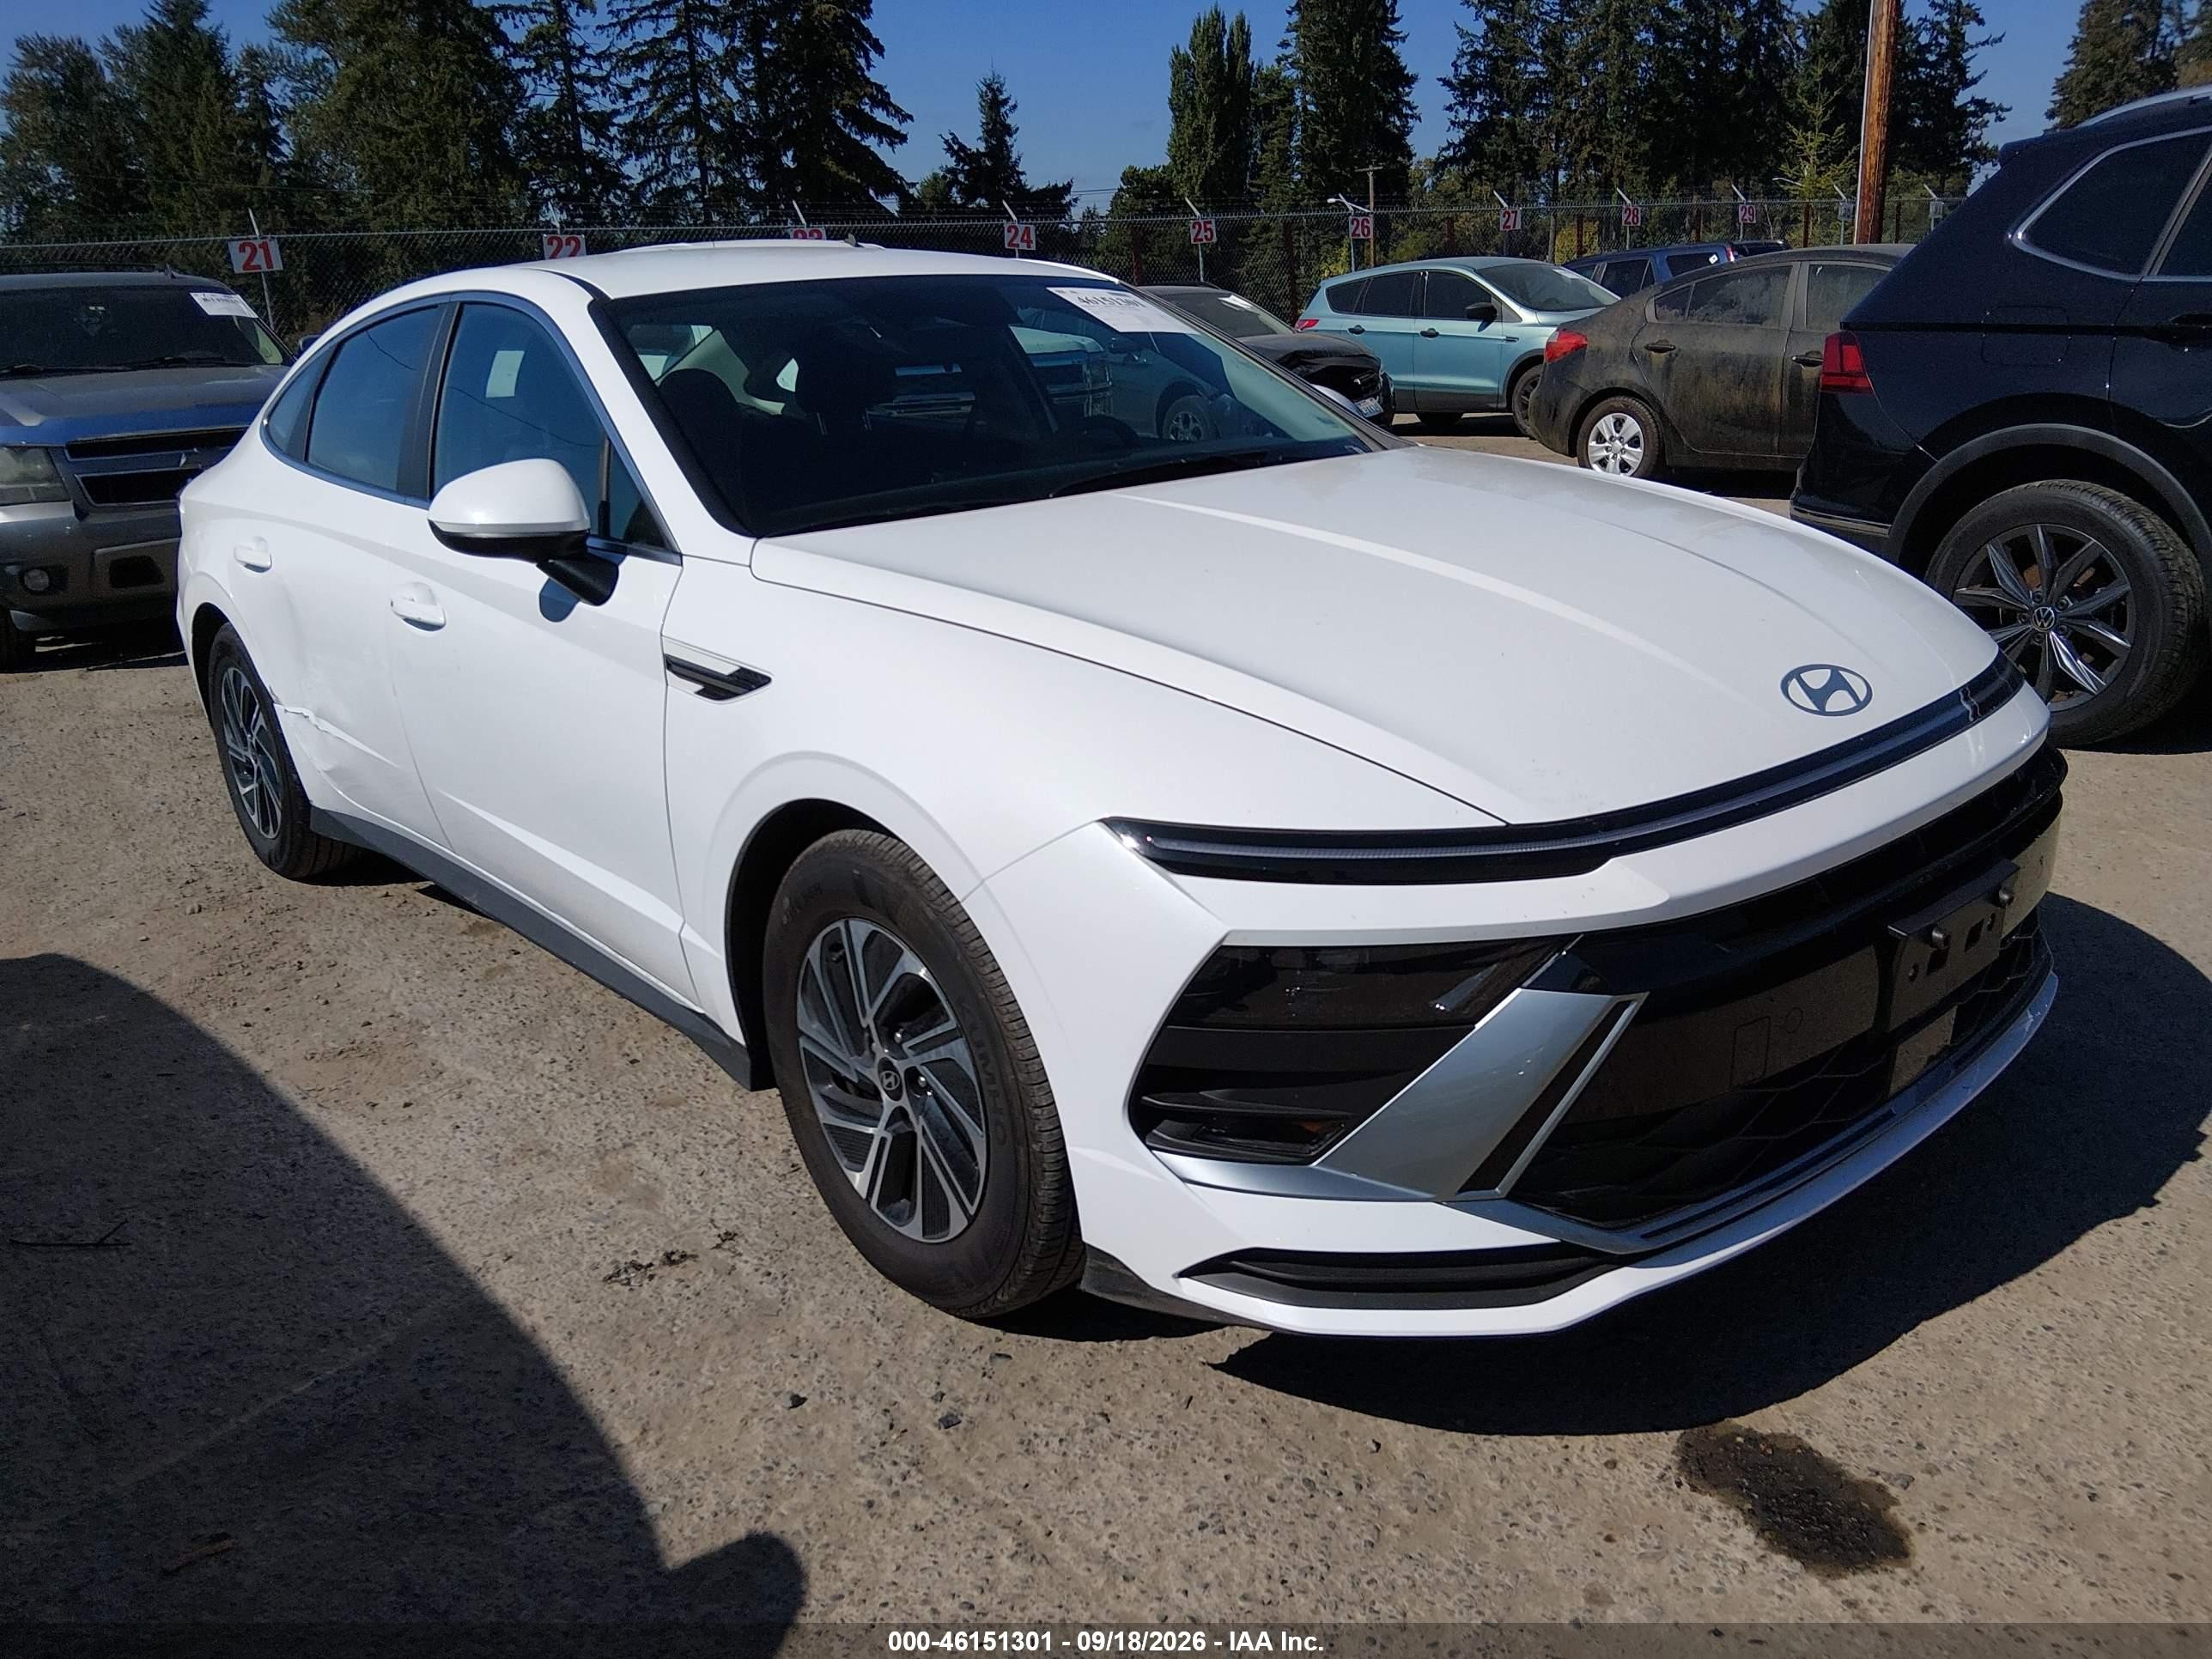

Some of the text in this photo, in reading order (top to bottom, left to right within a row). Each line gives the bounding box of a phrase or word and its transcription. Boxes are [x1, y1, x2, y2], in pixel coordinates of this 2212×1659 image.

[1503, 210, 1518, 229] 27
[1624, 207, 1639, 225] 28
[1741, 206, 1754, 222] 29
[1006, 224, 1034, 249] 24
[1192, 220, 1214, 242] 25
[1351, 217, 1370, 237] 26
[239, 241, 274, 270] 21
[547, 235, 581, 259] 22
